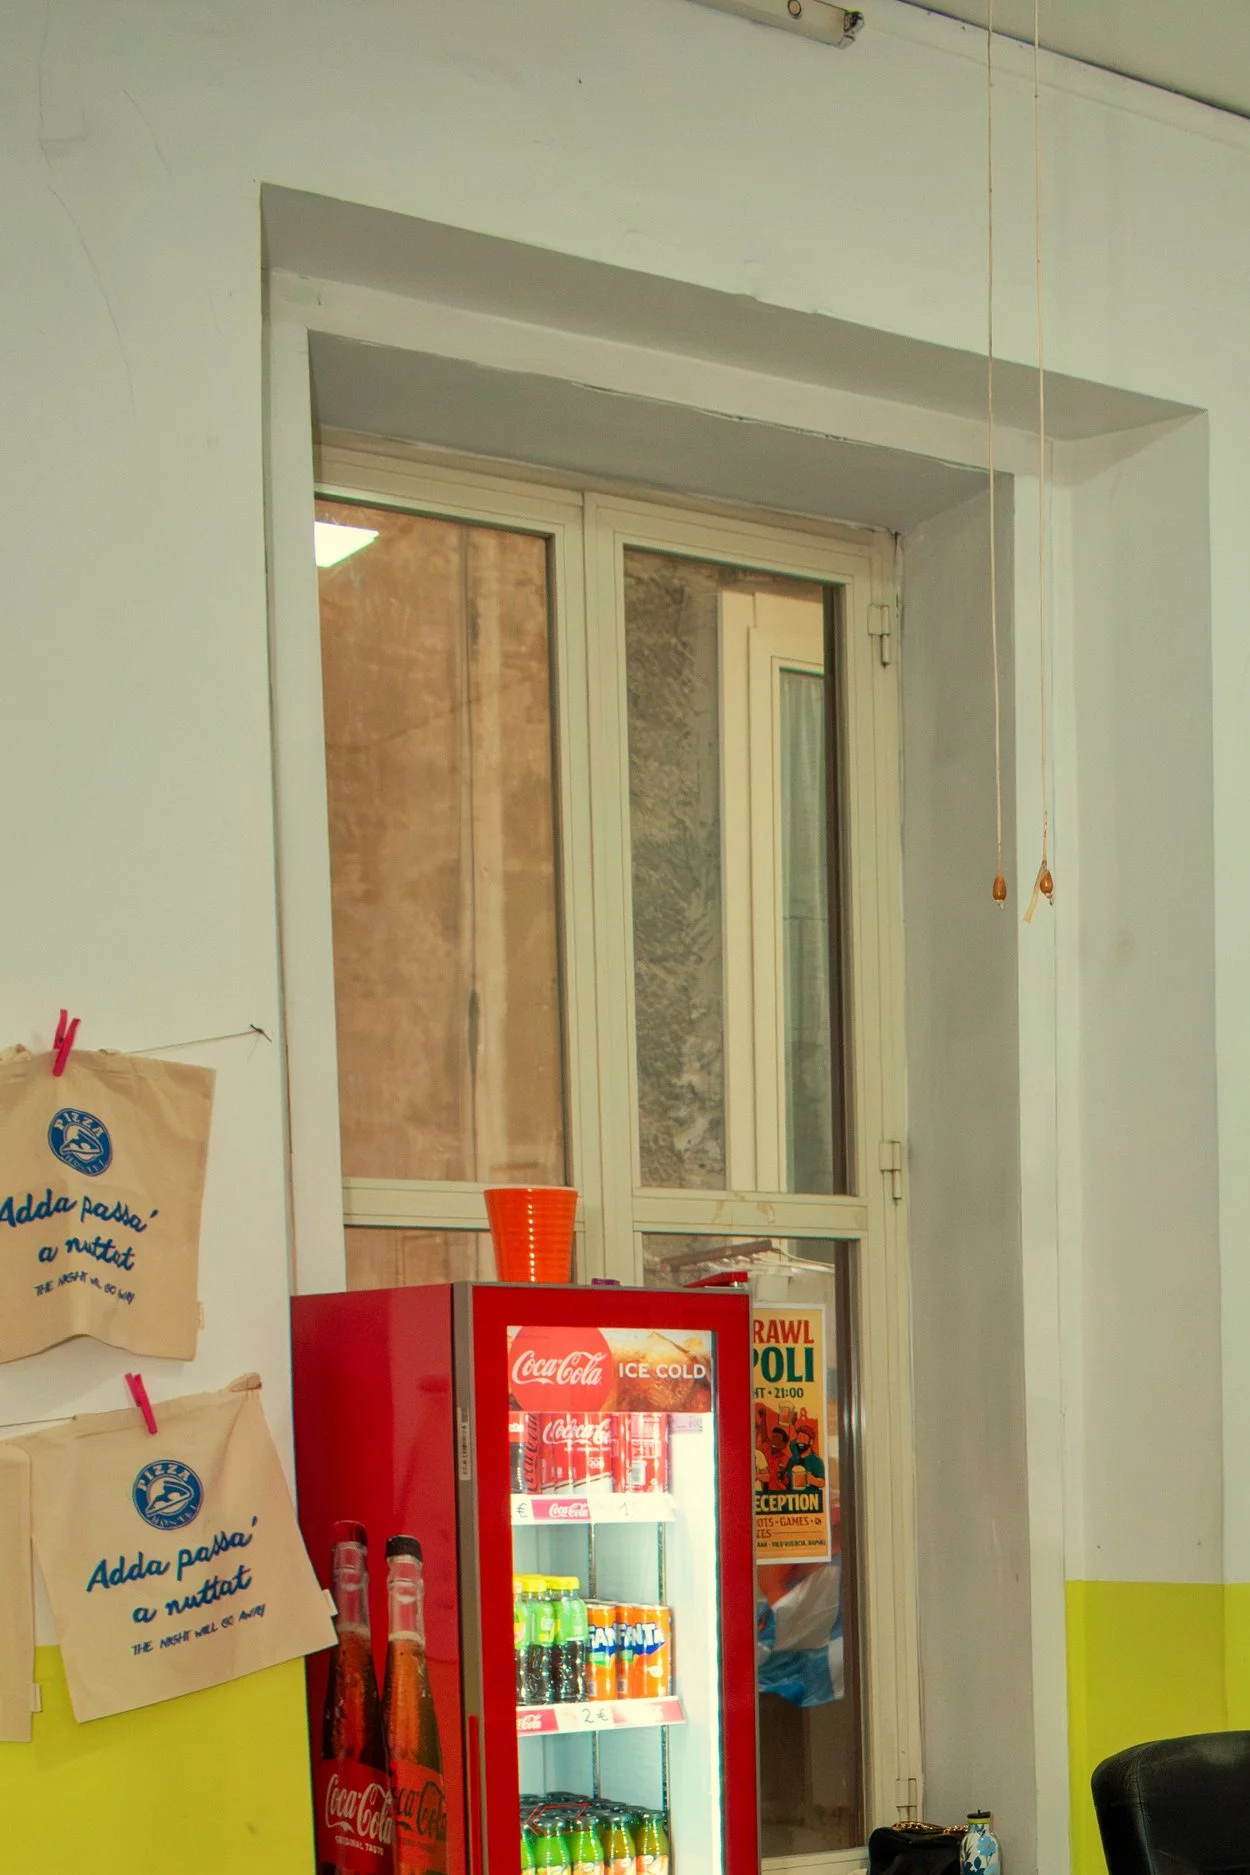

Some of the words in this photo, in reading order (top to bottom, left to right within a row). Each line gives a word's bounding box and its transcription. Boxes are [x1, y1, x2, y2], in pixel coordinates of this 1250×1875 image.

[54, 1112, 104, 1138] PIZZA
[0, 1188, 77, 1228] Adda
[38, 1245, 58, 1263] a
[34, 1280, 54, 1297] THE
[512, 1350, 607, 1385] Coca-Cola
[619, 1362, 650, 1378] ICE
[655, 1363, 706, 1379] COLD
[774, 1387, 804, 1400] 21:00
[136, 1463, 191, 1491] PIZZA
[86, 1551, 170, 1592] Adda
[132, 1606, 157, 1623] a
[165, 1565, 252, 1616] nuttat
[131, 1641, 154, 1656] THE
[160, 1629, 193, 1649] NIGHT
[325, 1773, 394, 1845] Coca-Cola
